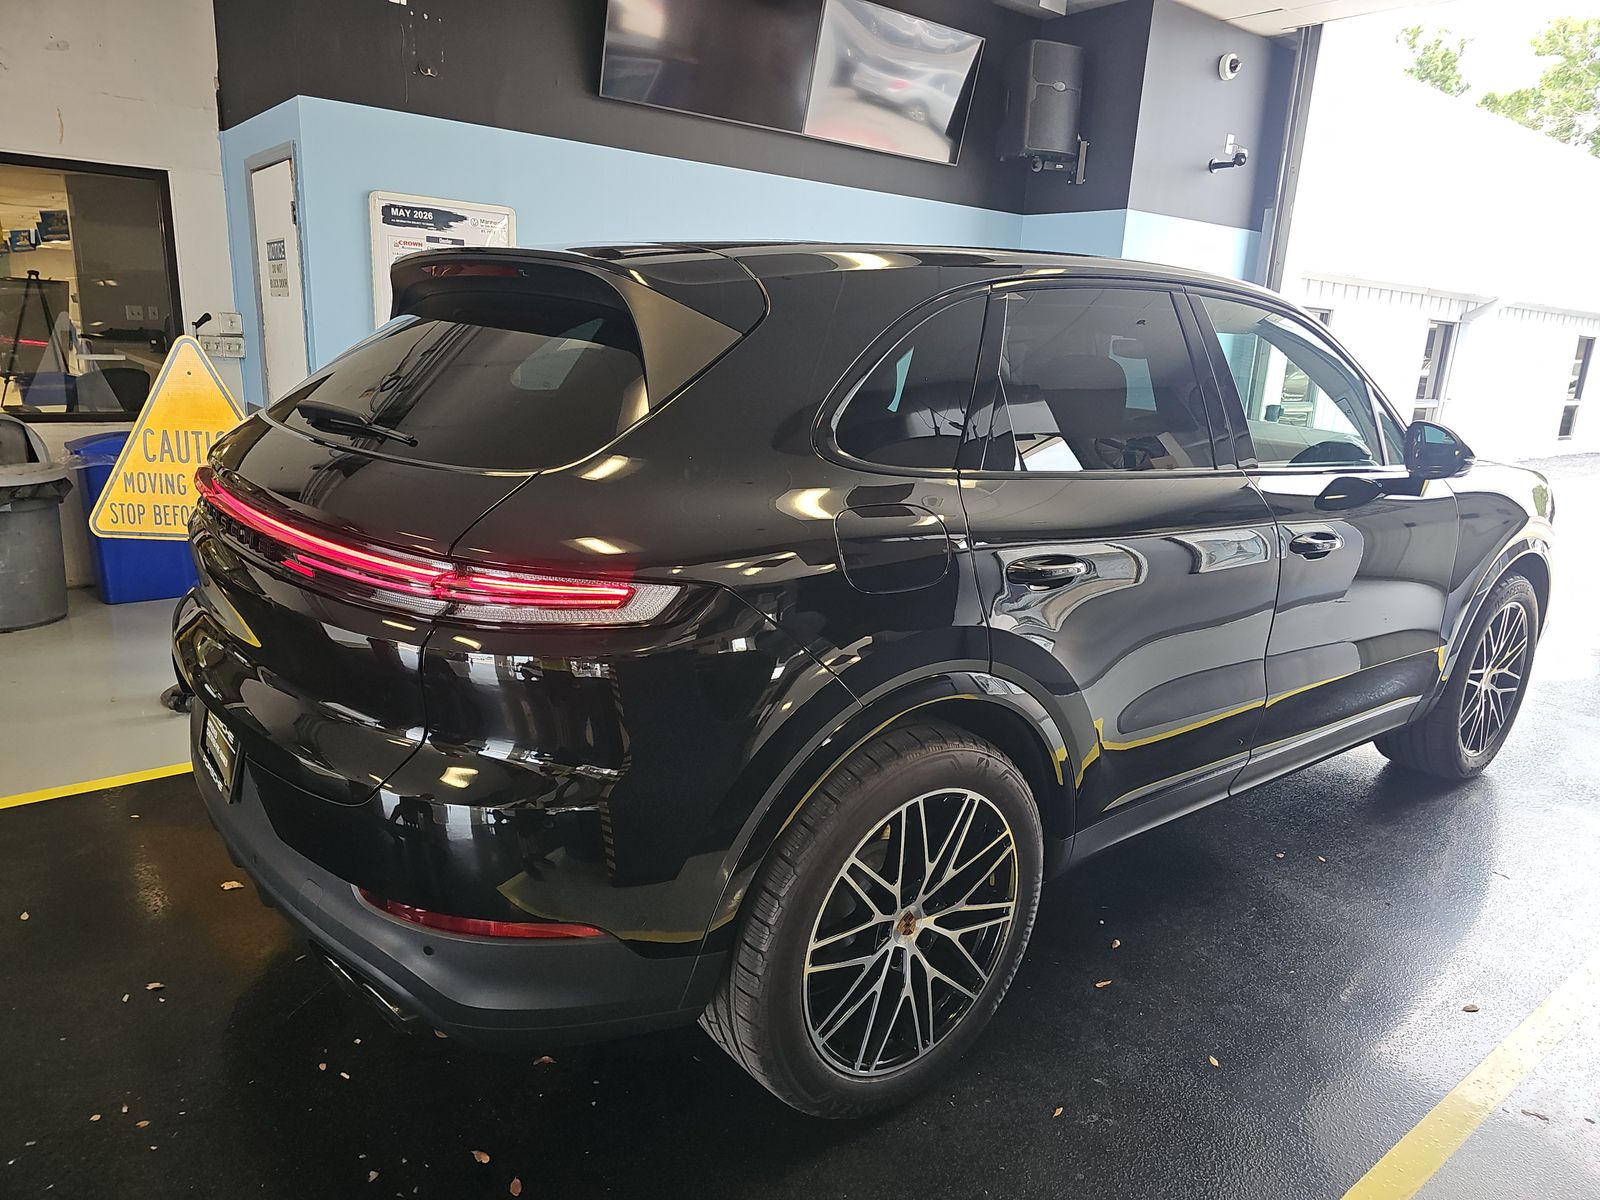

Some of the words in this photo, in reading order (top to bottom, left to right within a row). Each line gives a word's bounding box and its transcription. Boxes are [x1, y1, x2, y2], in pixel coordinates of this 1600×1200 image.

[391, 207, 411, 217] MAY
[413, 210, 433, 220] 2026
[142, 428, 226, 464] CAUTI
[123, 472, 187, 495] MOVING
[109, 503, 146, 526] STOP
